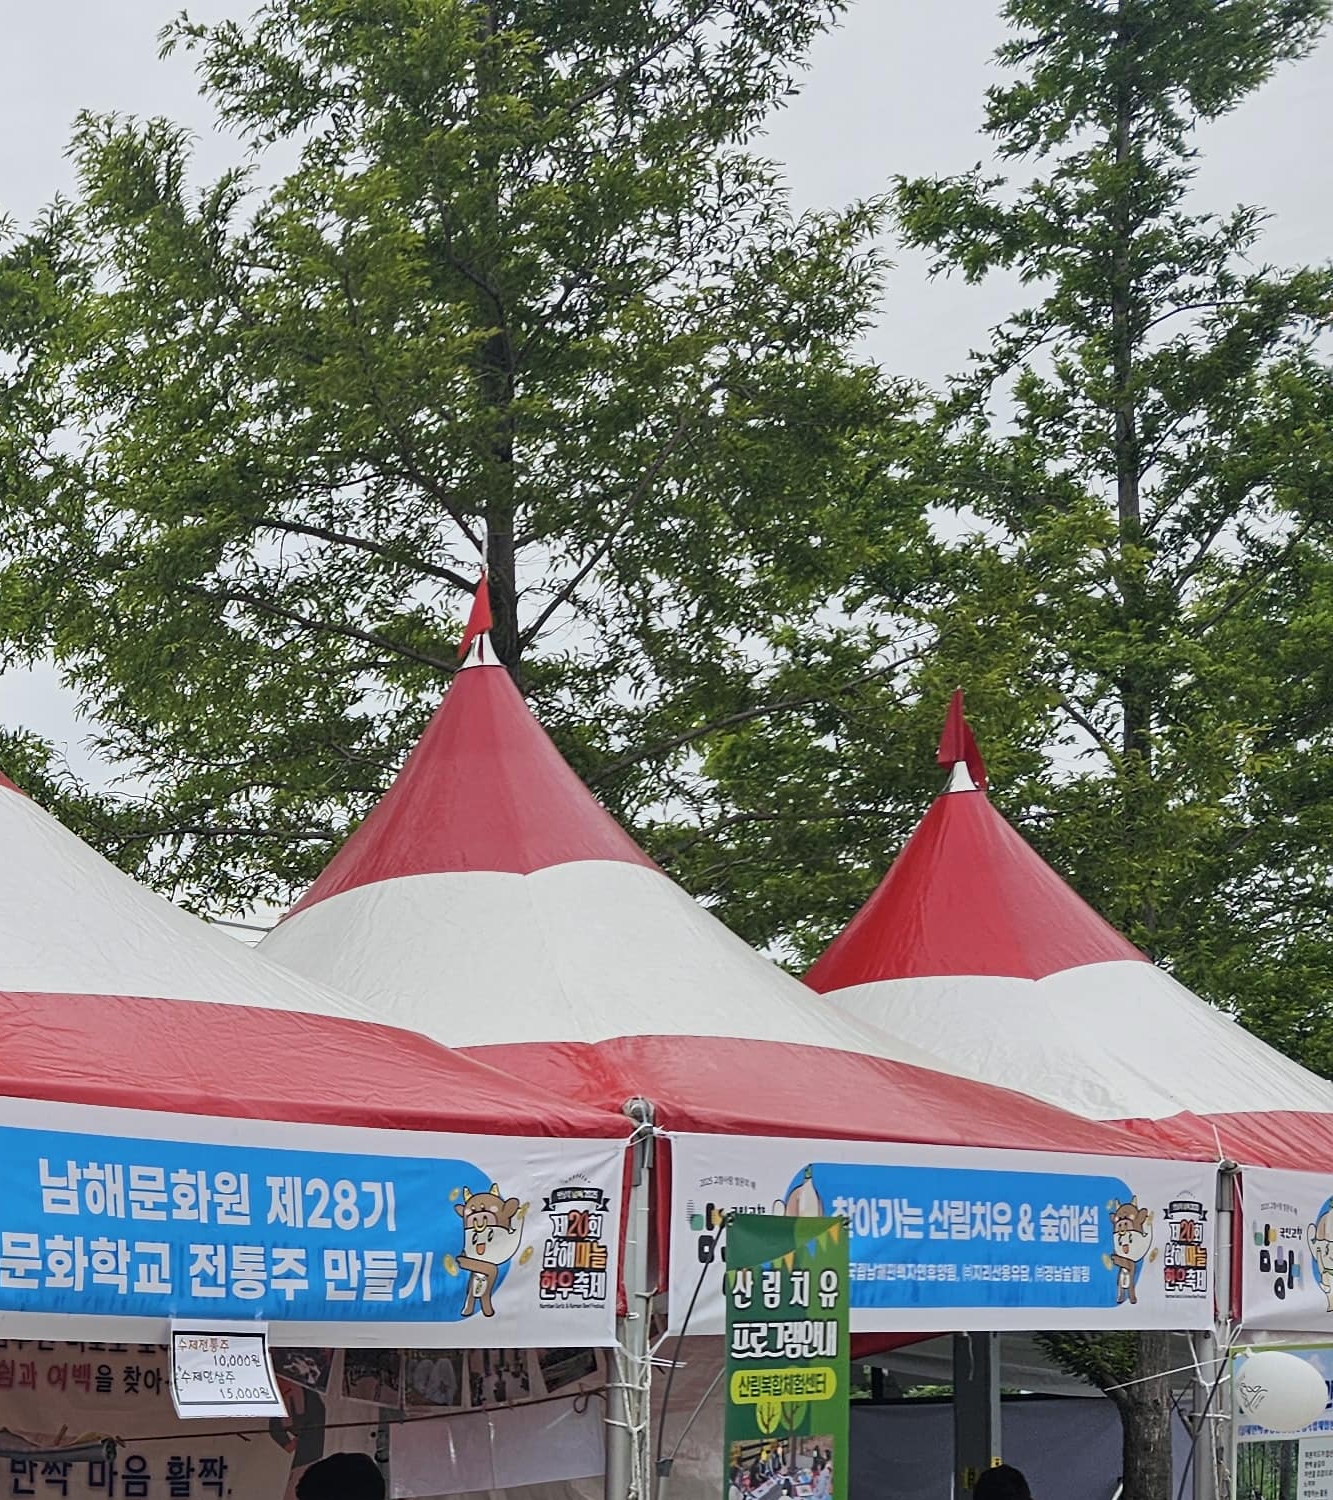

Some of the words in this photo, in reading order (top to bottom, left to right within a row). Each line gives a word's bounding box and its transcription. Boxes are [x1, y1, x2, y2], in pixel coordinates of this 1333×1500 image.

[38, 1158, 252, 1227] 남해문화원
[267, 1173, 397, 1232] 제28기
[550, 1210, 602, 1240] 제20회
[832, 1196, 925, 1239] 찾아가는
[928, 1199, 1012, 1242] 산림치유
[1017, 1204, 1035, 1242] &
[1040, 1204, 1099, 1243] 숲해설
[189, 1242, 310, 1301] 전통주
[323, 1249, 434, 1302] 만들기
[543, 1240, 608, 1269] 남해마늘
[539, 1271, 607, 1300] 한우축제
[732, 1269, 839, 1310] 산림치유
[178, 1337, 230, 1353] 수제전통주
[731, 1320, 838, 1359] 프로그램안내
[46, 1359, 114, 1395] 여백을
[122, 1365, 172, 1395] 찾아
[213, 1354, 262, 1368] 10,000원
[219, 1386, 272, 1400] 15,000원
[88, 1455, 151, 1498] 마음
